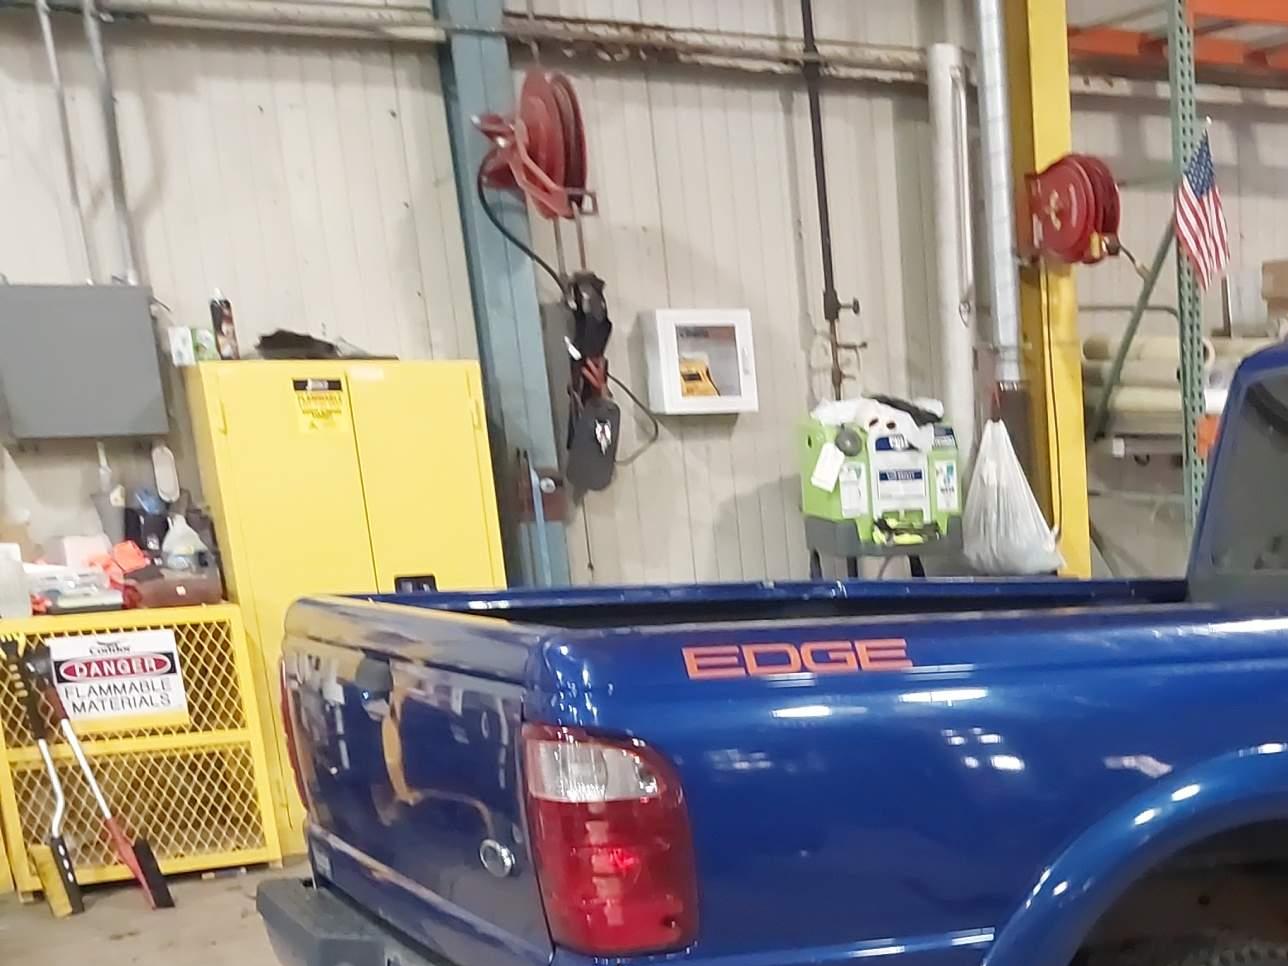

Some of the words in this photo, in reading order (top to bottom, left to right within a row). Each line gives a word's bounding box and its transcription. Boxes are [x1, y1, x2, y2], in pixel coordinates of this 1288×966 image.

[73, 656, 156, 678] DANGER
[682, 638, 914, 680] EDGE
[64, 678, 171, 699] FLAMMABLE
[72, 692, 172, 715] MATERIALS
